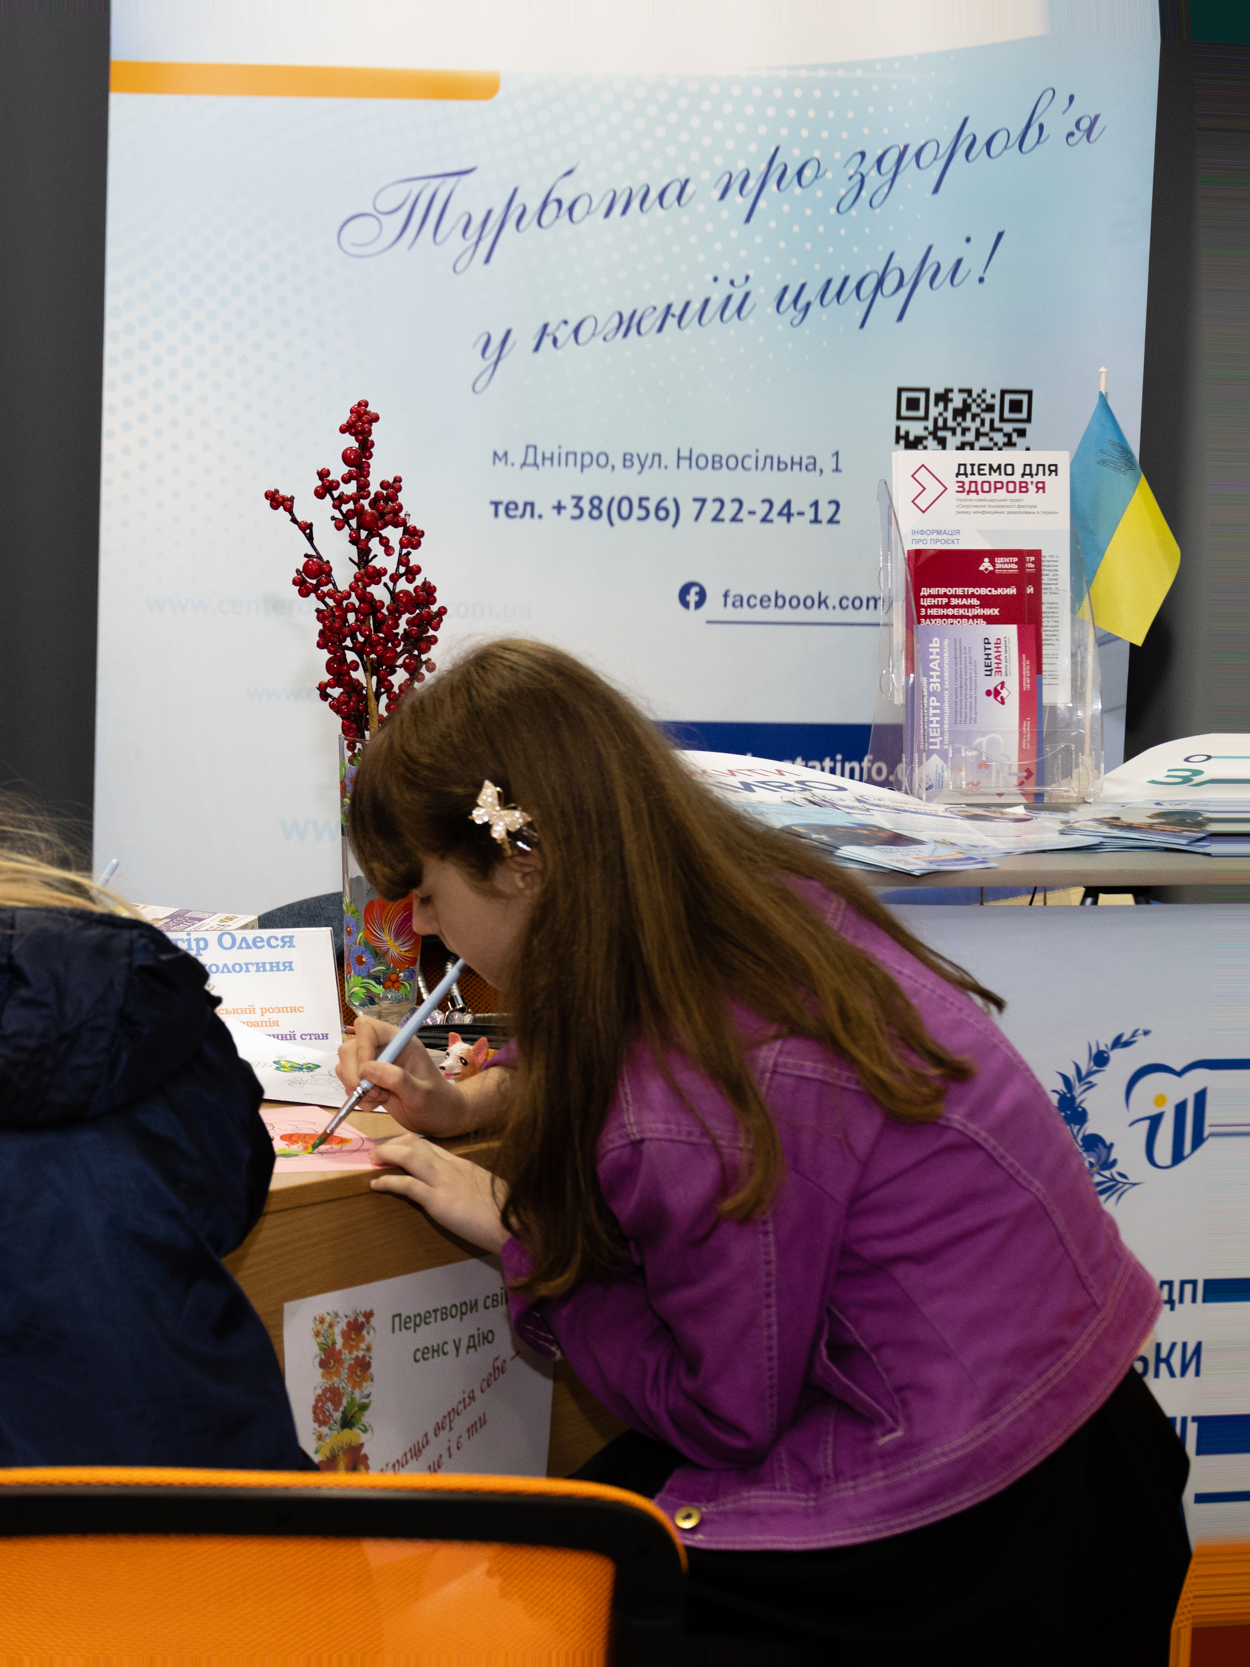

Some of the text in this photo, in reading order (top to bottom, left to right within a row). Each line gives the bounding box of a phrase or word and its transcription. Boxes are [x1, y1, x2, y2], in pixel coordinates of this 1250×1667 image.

[336, 160, 697, 276] Турбота
[714, 144, 827, 225] про
[472, 230, 1005, 395] у кожній цифрі!
[492, 444, 843, 477] м. Дніпро, вул. Новосільна, 1
[955, 463, 1058, 478] ДІЄМО ДЛЯ
[490, 495, 842, 529] тел. +38(056) 722-24-12
[911, 529, 961, 537] ІНФОРМАЦІЯ
[920, 586, 1017, 596] ДНІПРОПЕТРОВСЬКИЙ
[920, 597, 980, 606] ЦЕНТР ЗНАНЬ
[927, 606, 1000, 616] НЕІНФЕКЦІЙНИХ
[928, 637, 941, 694] ЗНАНЬ
[983, 637, 994, 677] ЦЕНТР
[994, 637, 1003, 677] ЗНАНЬ
[929, 695, 943, 750] ЦЕНТР
[705, 780, 848, 793] ИВО
[171, 931, 296, 956] гір Олеся
[203, 961, 295, 974] ологиня
[260, 1005, 305, 1017] розпис
[300, 1032, 329, 1041] стан
[392, 1298, 478, 1334] Перетвори
[413, 1327, 495, 1363] сенс у дію
[433, 1387, 476, 1438] версія
[480, 1354, 507, 1394] себе
[427, 1412, 488, 1475] це і є ти
